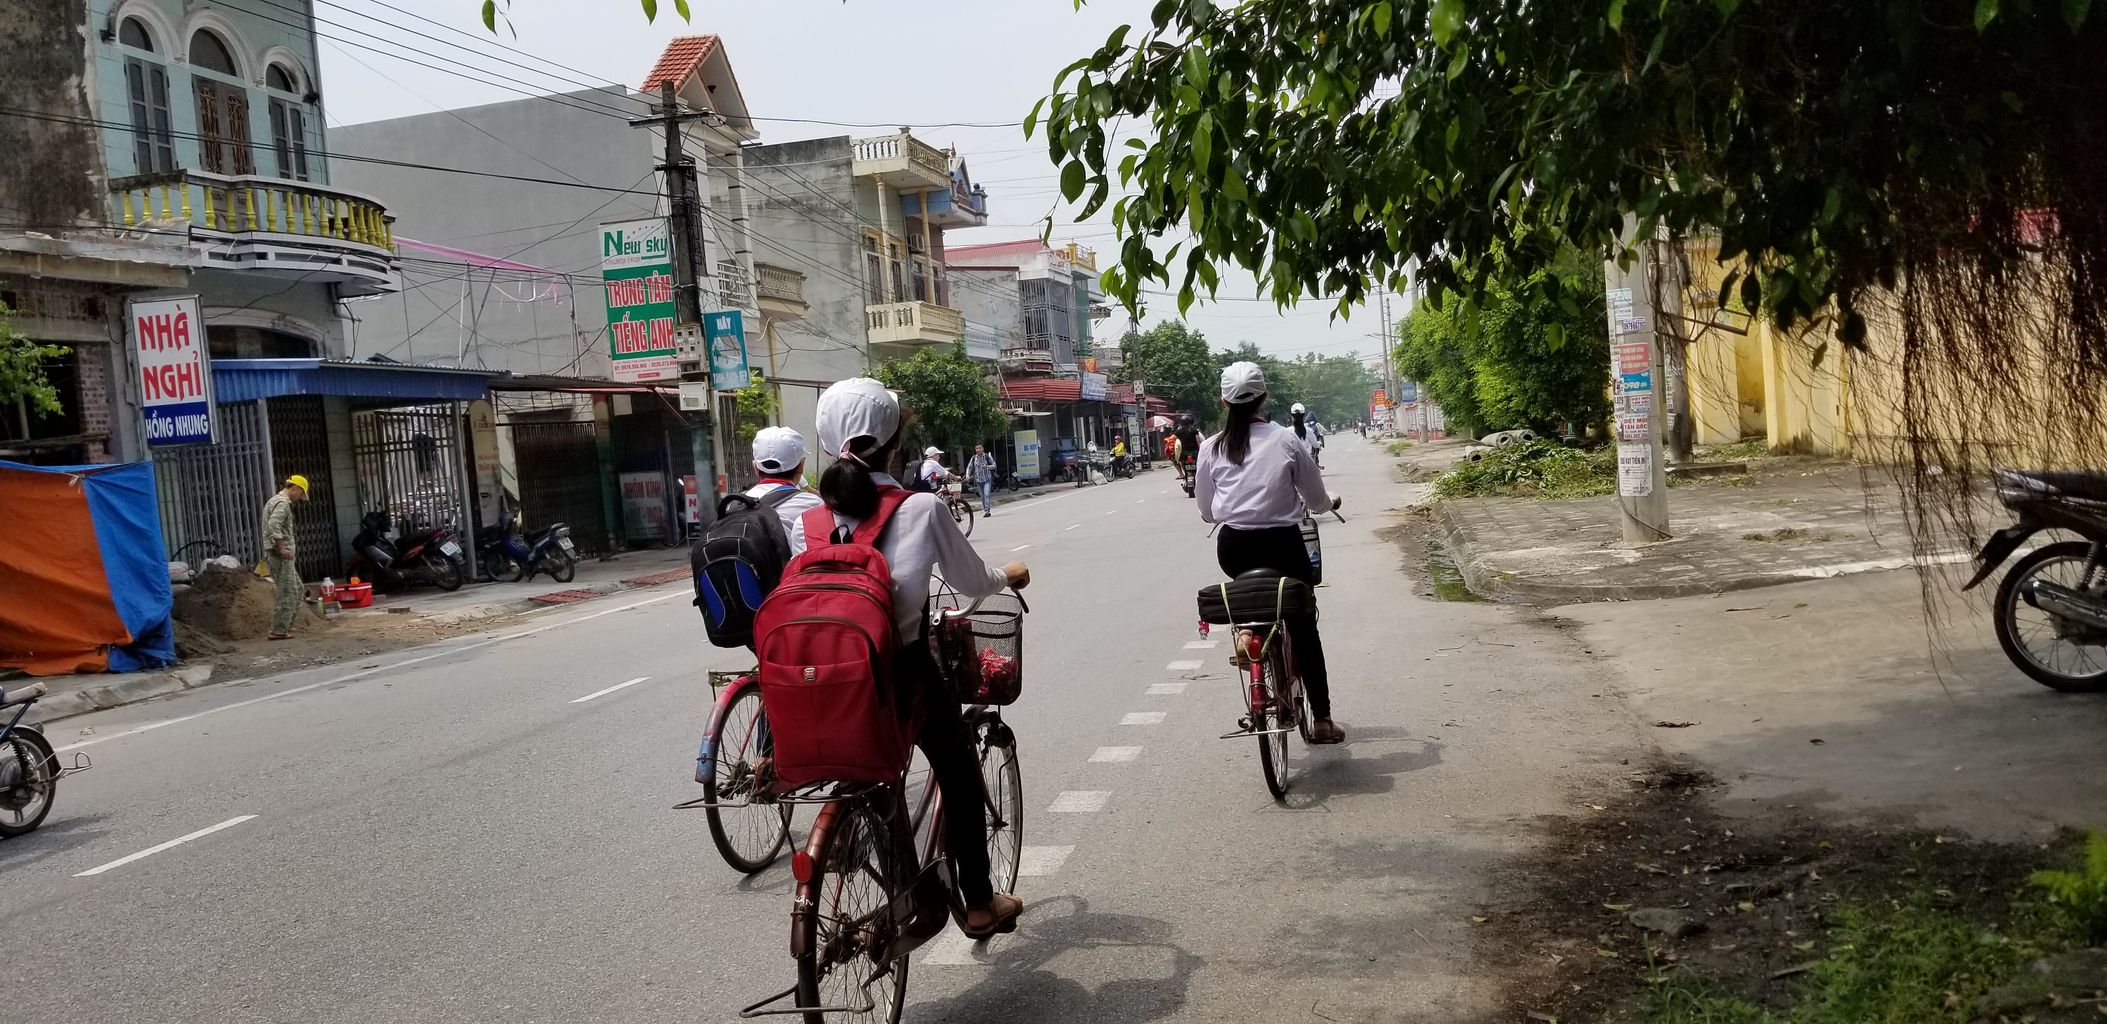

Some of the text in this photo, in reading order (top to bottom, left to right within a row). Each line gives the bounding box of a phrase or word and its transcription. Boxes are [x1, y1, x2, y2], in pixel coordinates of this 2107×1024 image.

[604, 230, 640, 257] New
[607, 270, 672, 307] TRUNG TÂM
[138, 304, 190, 353] NHÀ
[612, 311, 676, 354] TIẾNG ANH
[143, 351, 201, 401] NGHỈ
[145, 410, 208, 439] HỒNG NHUNG
